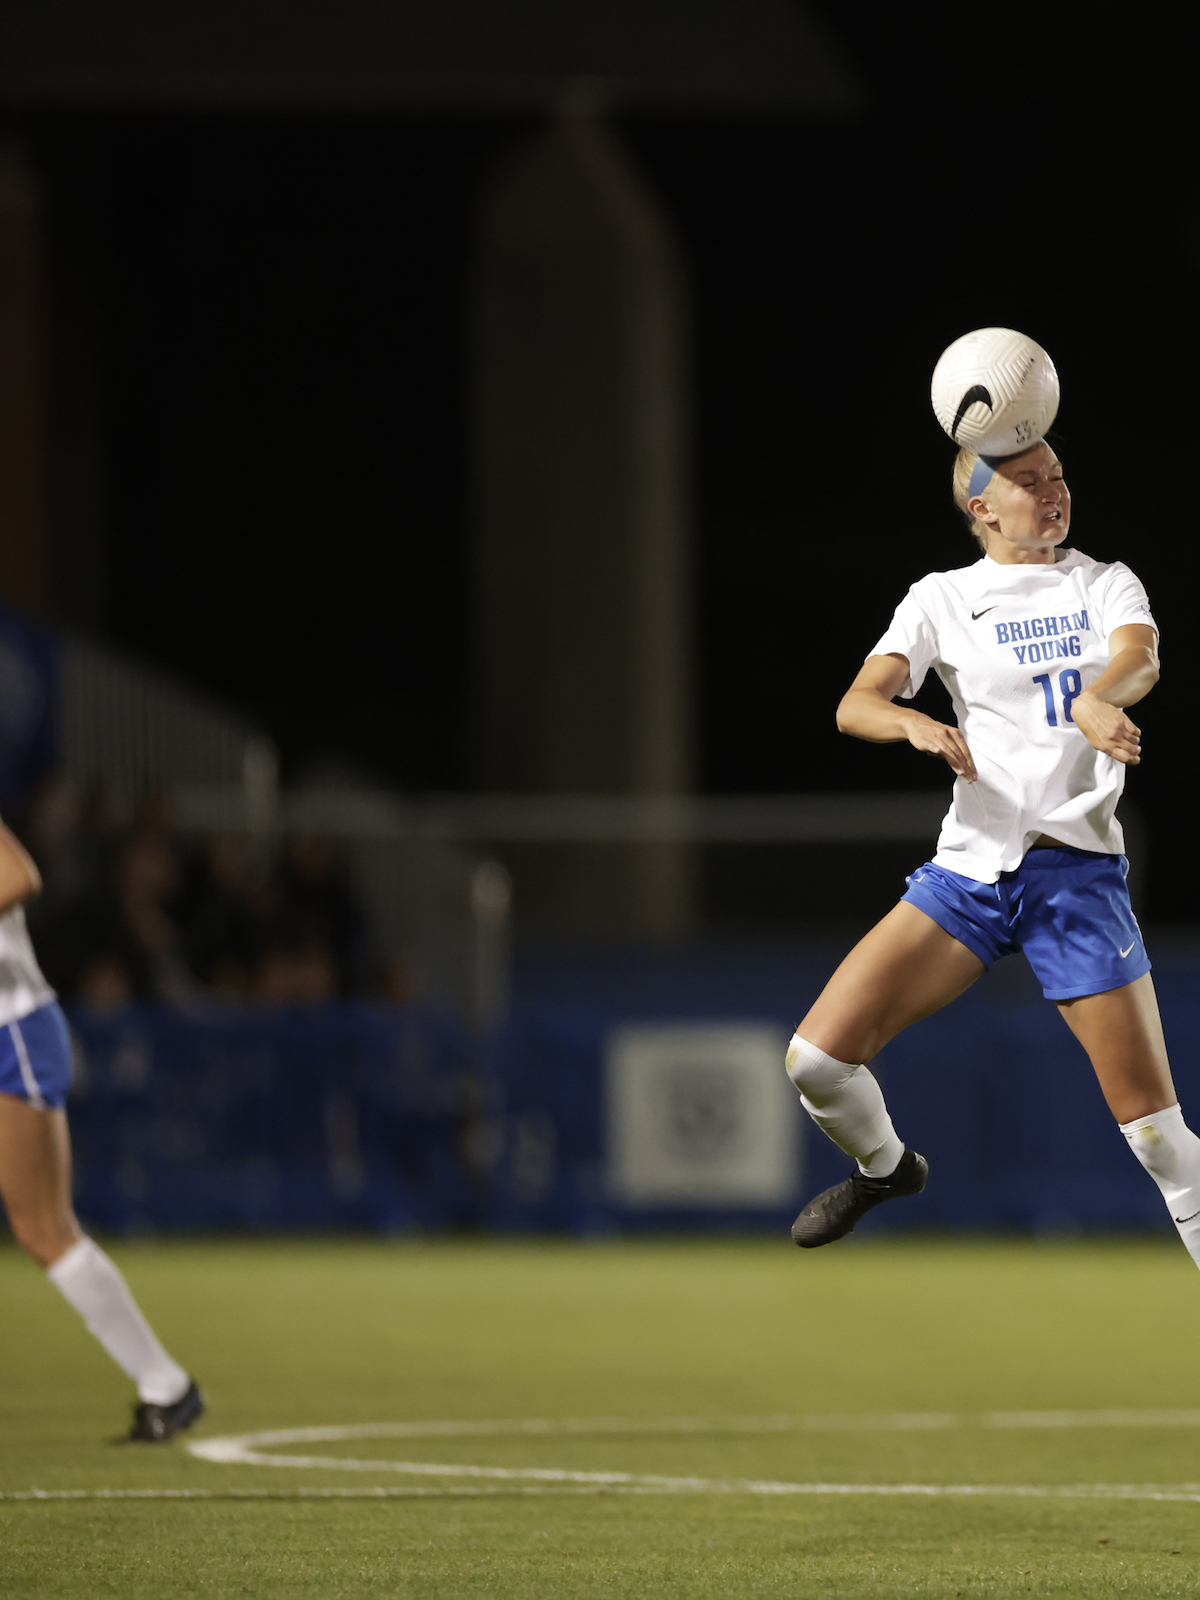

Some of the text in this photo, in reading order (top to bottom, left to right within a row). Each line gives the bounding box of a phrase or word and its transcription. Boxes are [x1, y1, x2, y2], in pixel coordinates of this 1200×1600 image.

[995, 610, 1091, 645] BRIGHAM
[1012, 635, 1082, 665] YOUNG
[1032, 668, 1082, 727] 18
